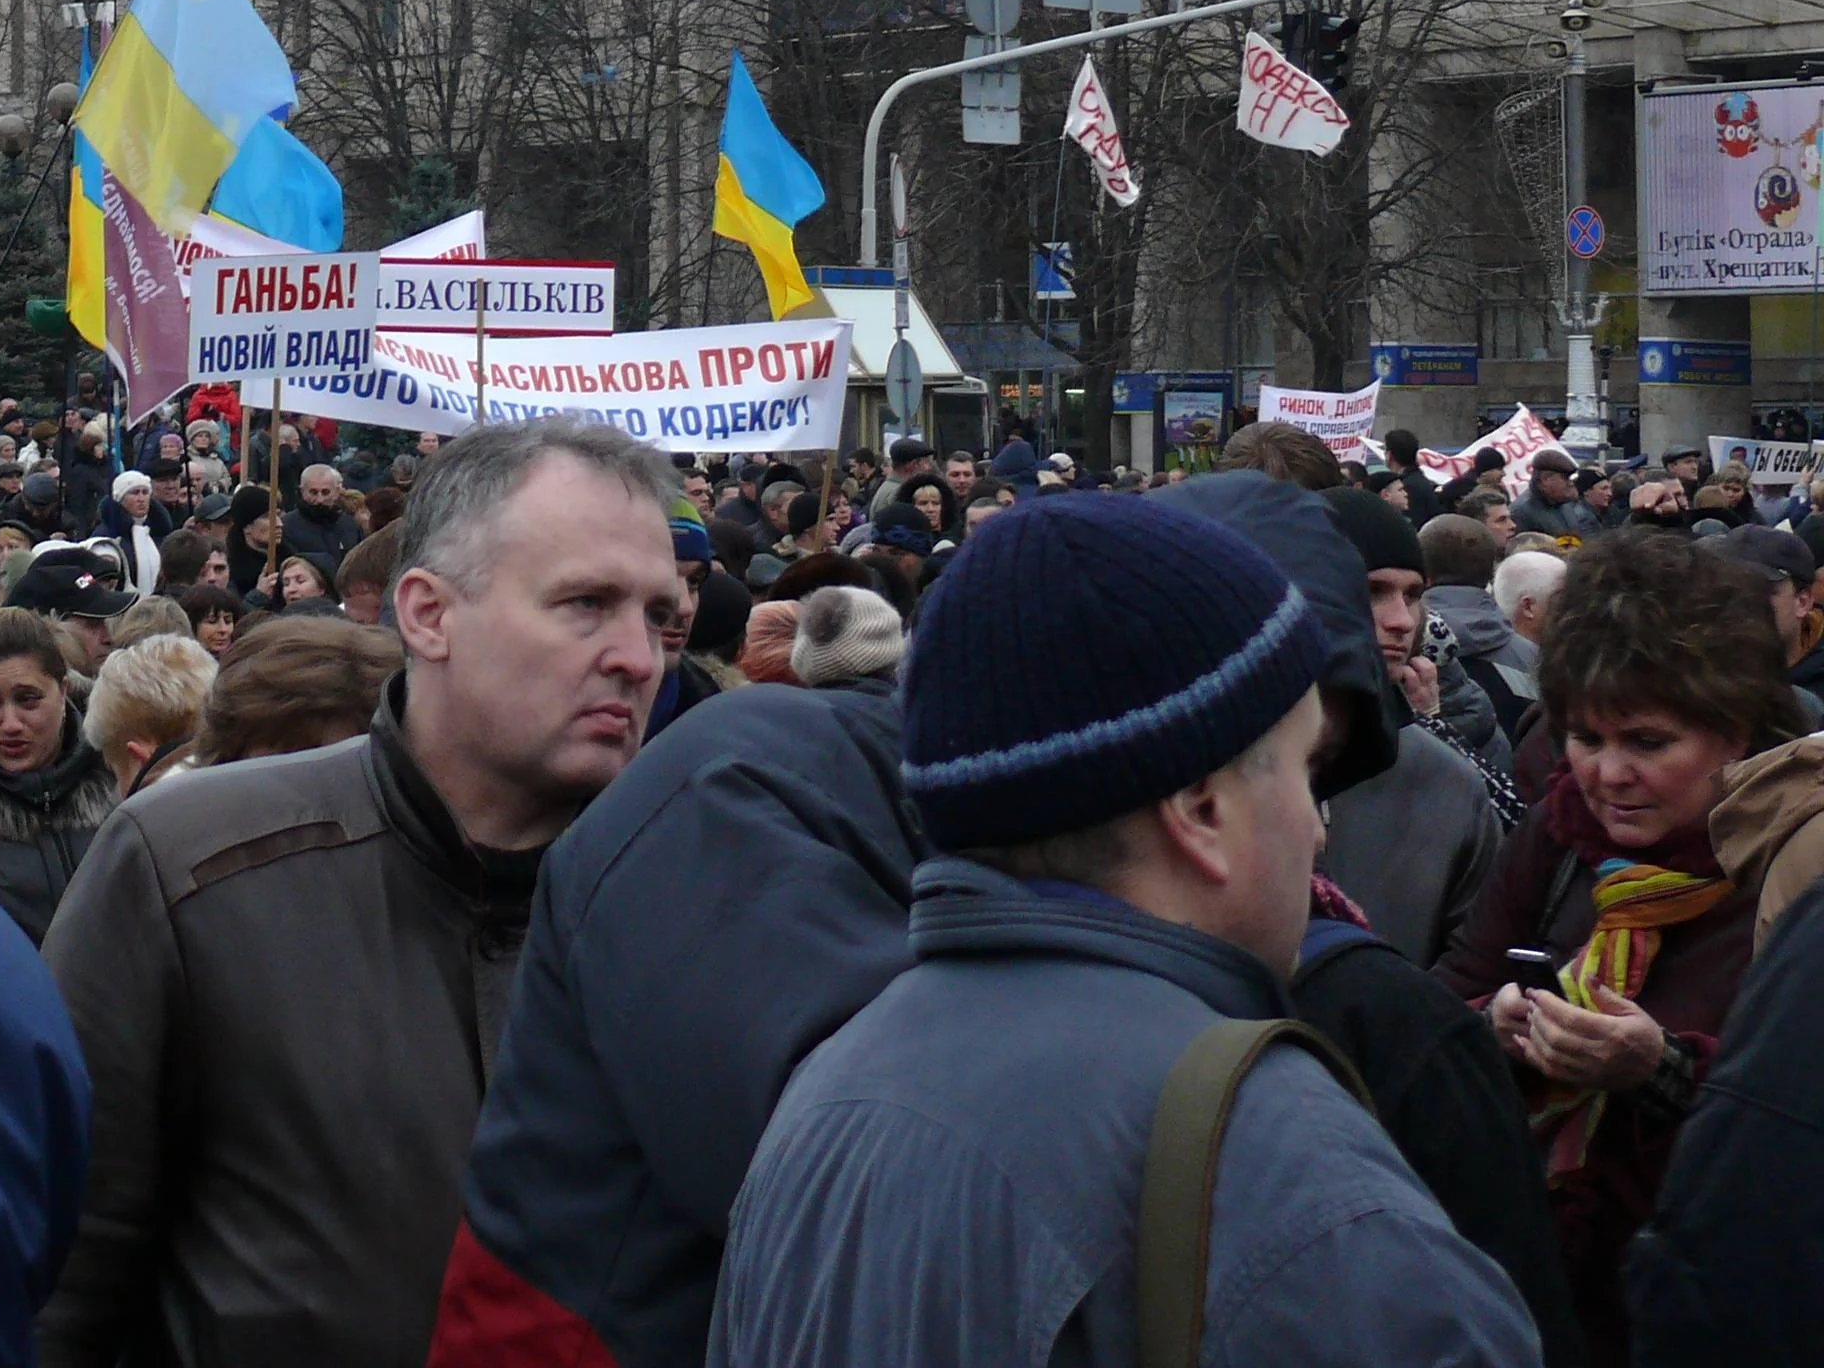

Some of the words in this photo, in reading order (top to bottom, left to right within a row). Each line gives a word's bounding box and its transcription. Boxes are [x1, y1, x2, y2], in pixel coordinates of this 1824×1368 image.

[216, 263, 357, 315] ГАНЬБА!
[198, 324, 276, 373] НОВІЙ
[285, 328, 371, 372] ВЛАДІ
[698, 340, 836, 388] ПРОТИ
[658, 395, 809, 440] КОДЕКСУ!
